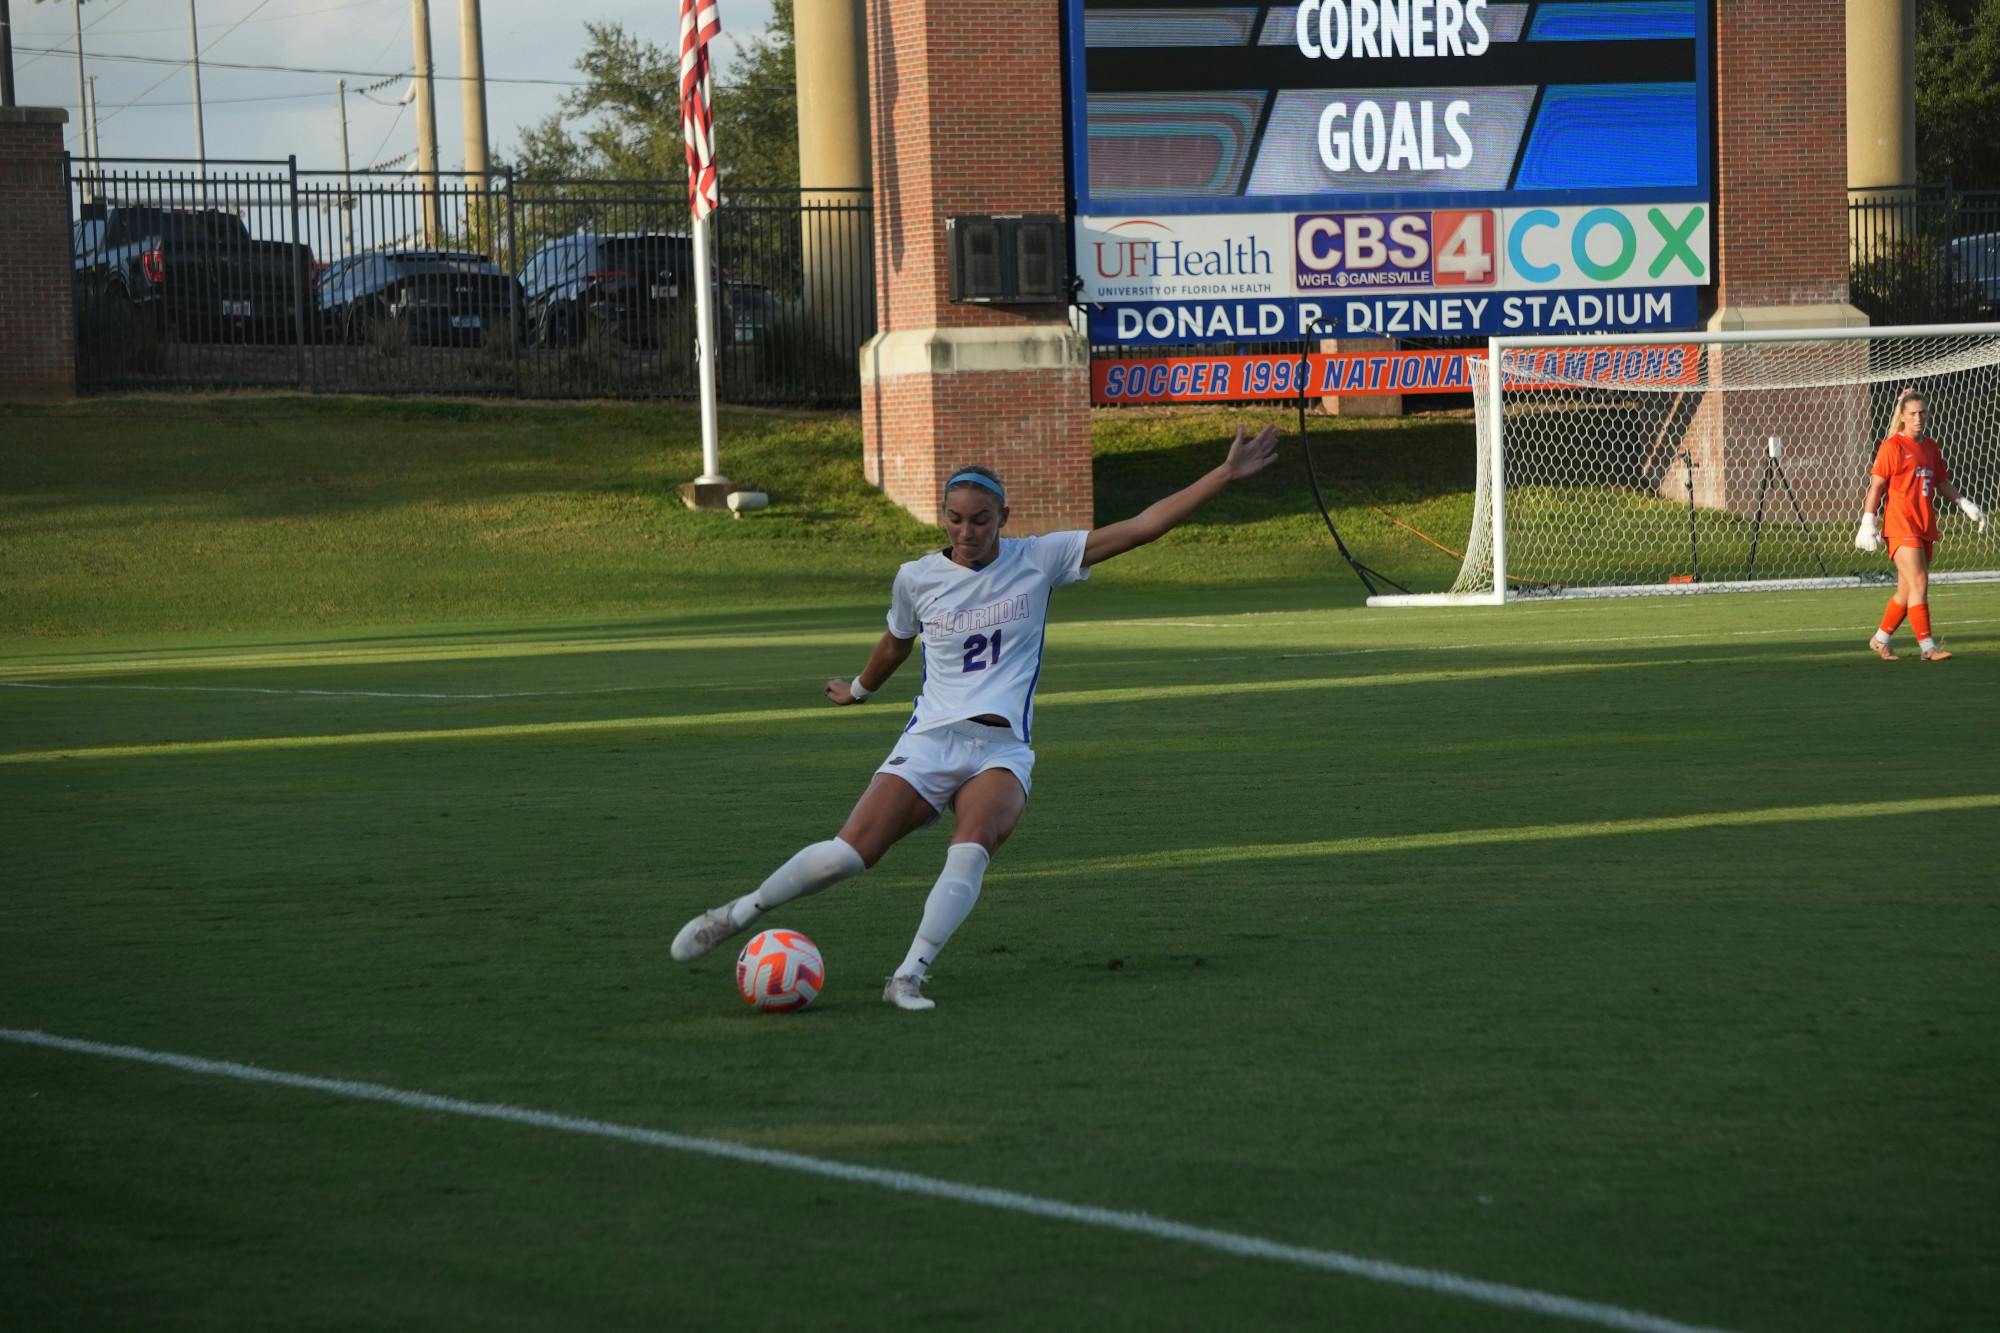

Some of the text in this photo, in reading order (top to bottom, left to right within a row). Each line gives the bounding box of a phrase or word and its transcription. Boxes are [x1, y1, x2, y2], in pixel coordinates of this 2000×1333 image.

[1296, 0, 1490, 59] CORNERS
[1318, 100, 1473, 172] GOALS
[1297, 214, 1492, 282] CBS 4
[1507, 206, 1706, 284] COX
[1098, 283, 1271, 297] UNIVERSITY OF FLORIDA HEALTH
[1298, 271, 1430, 287] WGFL GAINESVILLE
[1117, 292, 1672, 340] DONALD R. DIZNEY STADIUM
[1104, 361, 1232, 398] SOCCER
[1241, 359, 1312, 394] 1998
[1501, 347, 1685, 386] CHAMPIONS
[930, 593, 1030, 639] FLORIDA
[962, 628, 1002, 673] 21
